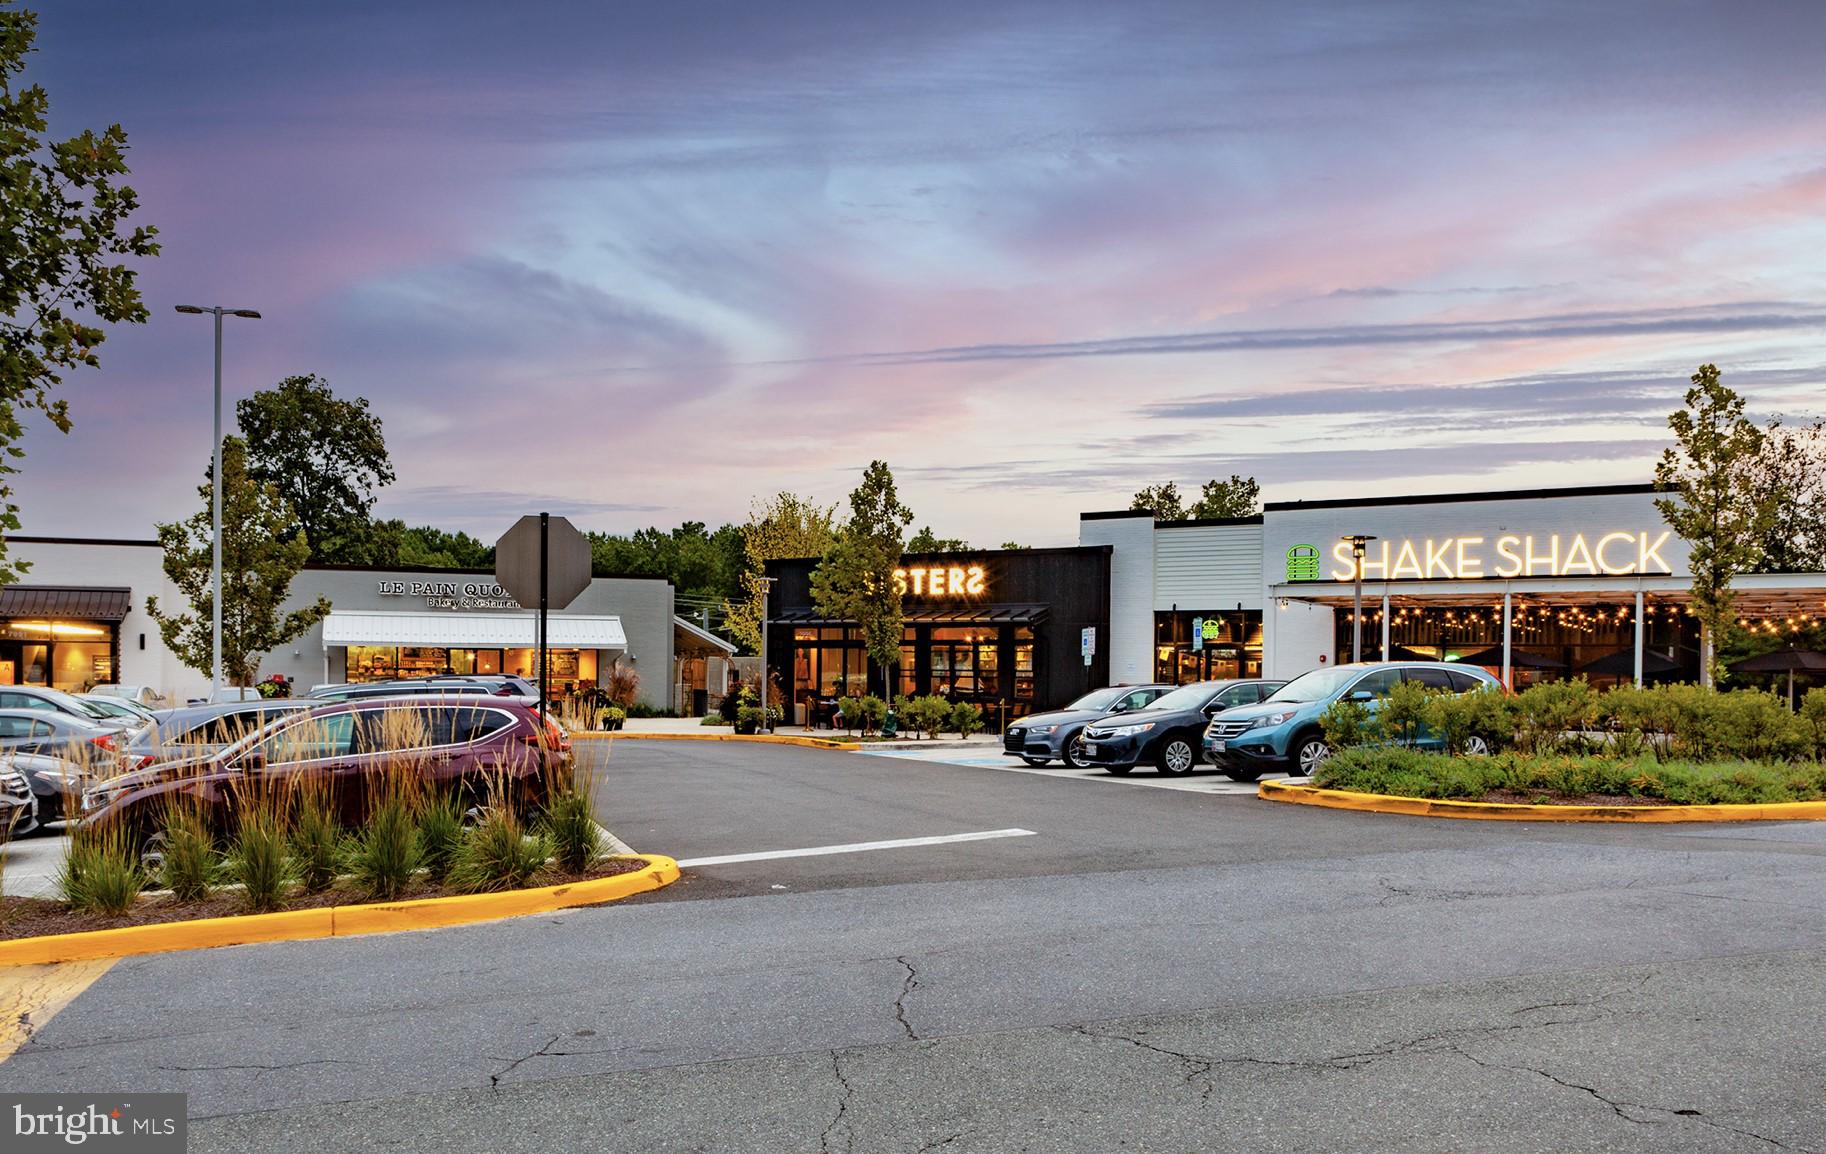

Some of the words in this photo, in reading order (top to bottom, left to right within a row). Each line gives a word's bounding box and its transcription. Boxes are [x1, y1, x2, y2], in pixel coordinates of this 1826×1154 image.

[1331, 537, 1485, 582] SHAKE
[1494, 531, 1672, 578] SHACK
[379, 581, 404, 595] LE
[411, 582, 457, 596] PAIN
[464, 583, 512, 598] QUO
[863, 566, 985, 596] STERS
[427, 597, 460, 610] Bakery
[462, 598, 470, 608] &
[472, 598, 522, 609] Restauran
